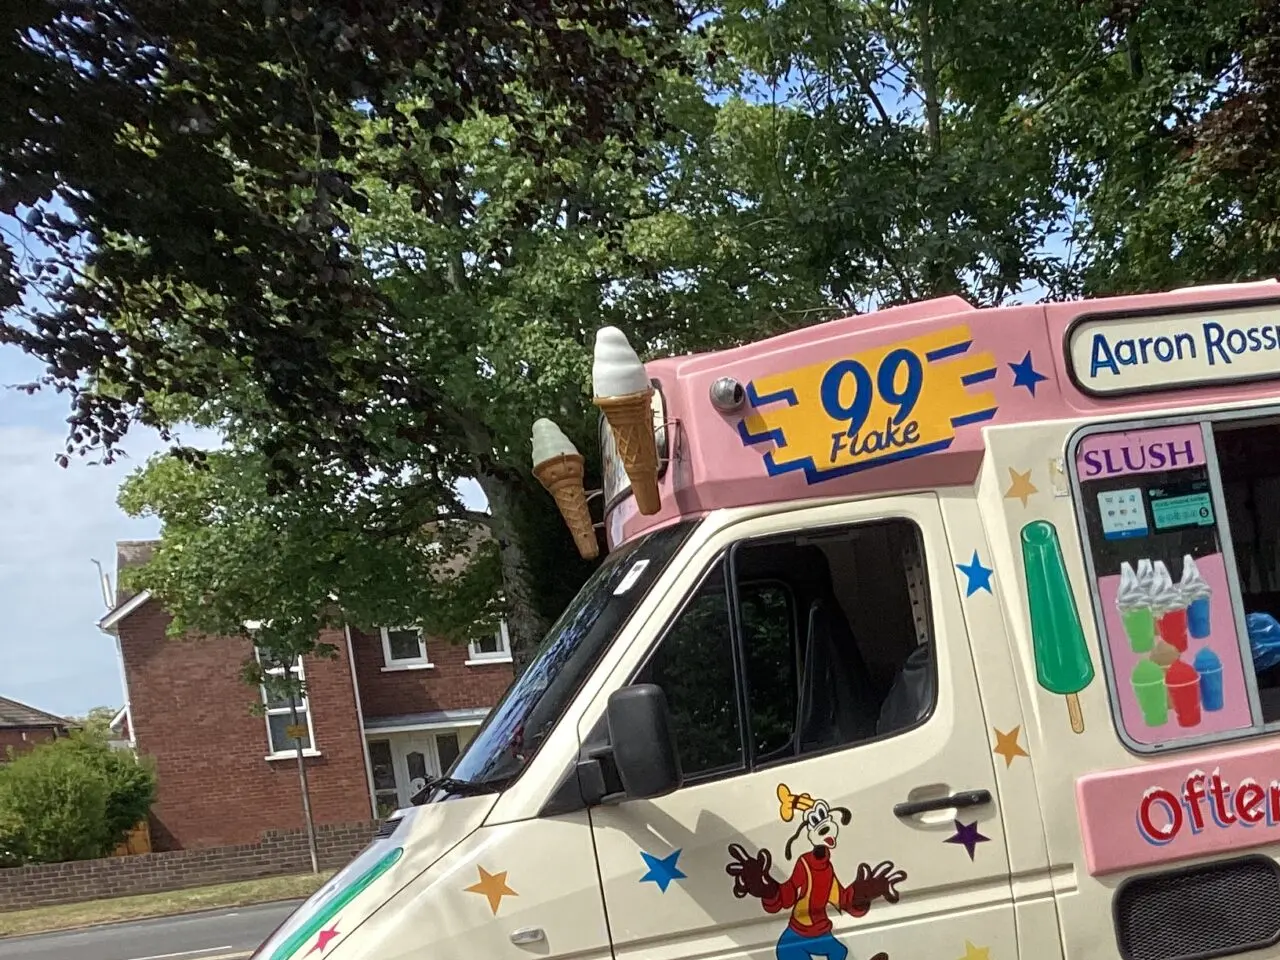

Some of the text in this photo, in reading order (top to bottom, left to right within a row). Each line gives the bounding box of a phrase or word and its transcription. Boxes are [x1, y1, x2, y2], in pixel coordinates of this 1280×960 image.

[1090, 331, 1197, 379] Aaron
[821, 348, 924, 437] 99
[830, 417, 921, 463] Flake
[1084, 440, 1195, 477] SLUSH
